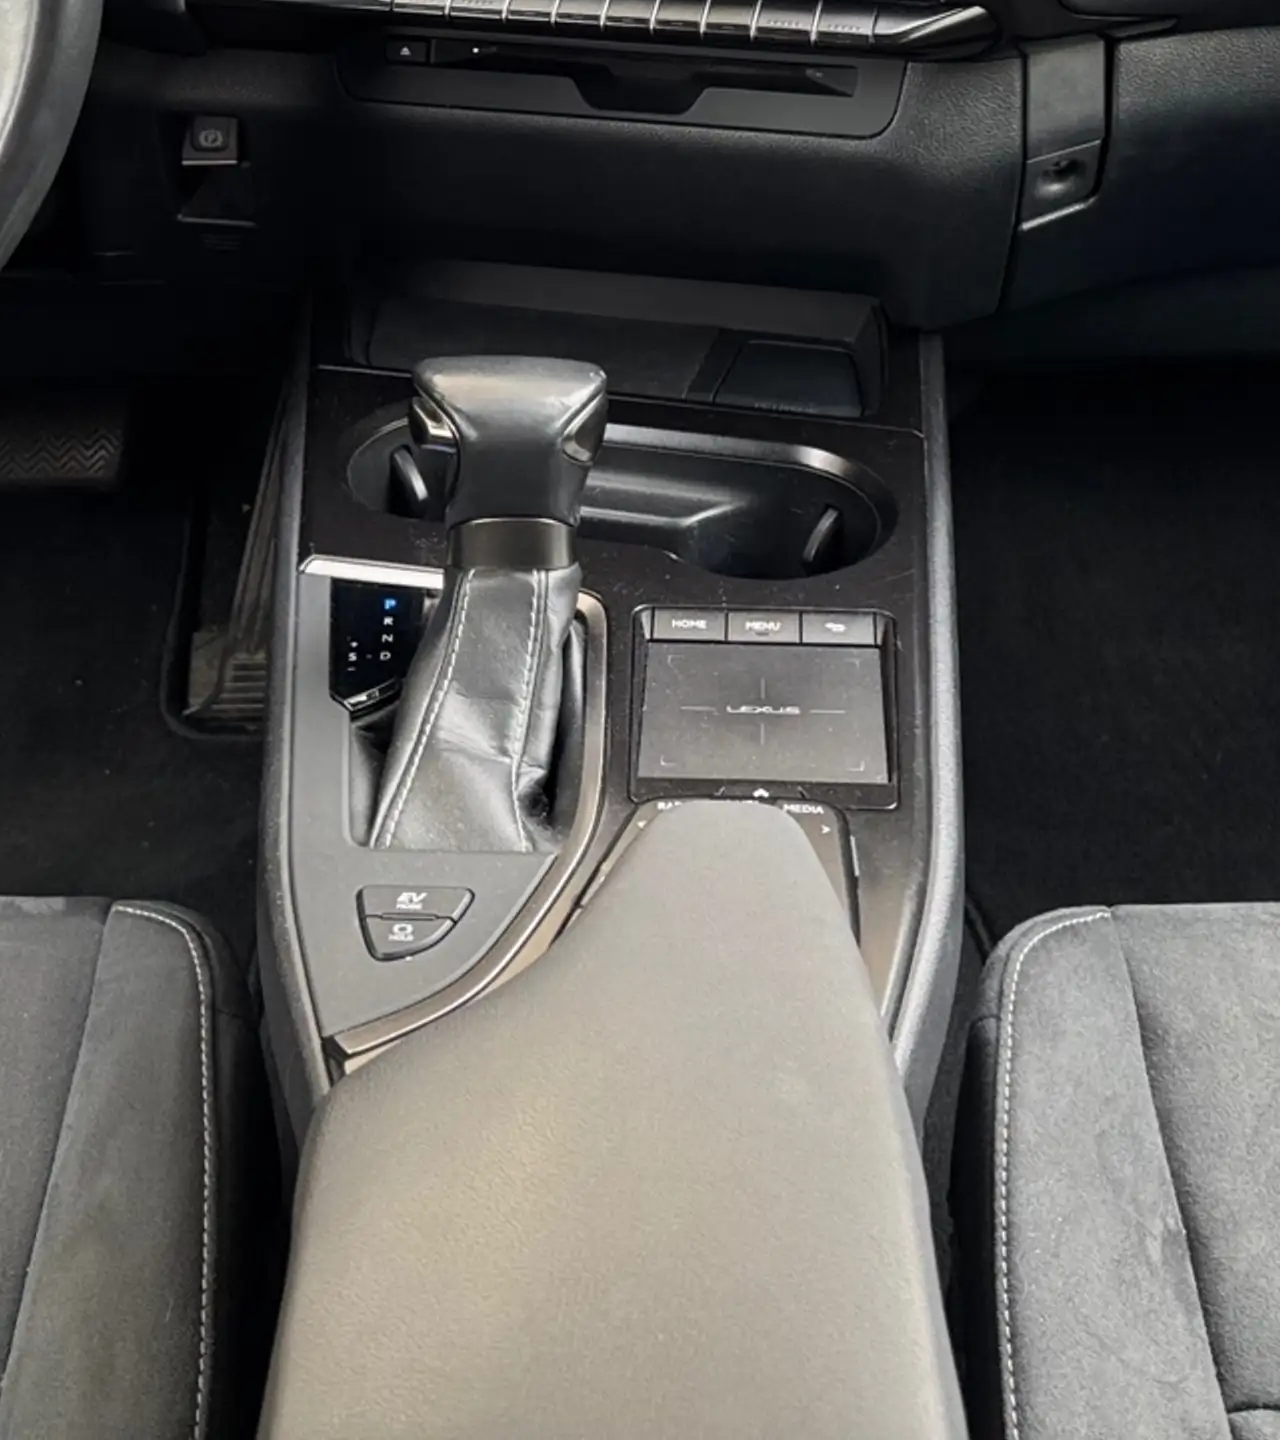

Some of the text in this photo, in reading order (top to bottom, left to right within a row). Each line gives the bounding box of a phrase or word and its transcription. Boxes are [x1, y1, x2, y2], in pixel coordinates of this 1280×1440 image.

[383, 598, 397, 610] P
[383, 616, 395, 626] R
[670, 618, 709, 630] HOME
[743, 620, 782, 632] MENU
[381, 633, 395, 644] N
[347, 652, 358, 663] S
[379, 651, 392, 661] D
[725, 704, 801, 715] LEXUS
[782, 803, 825, 815] MEDIA
